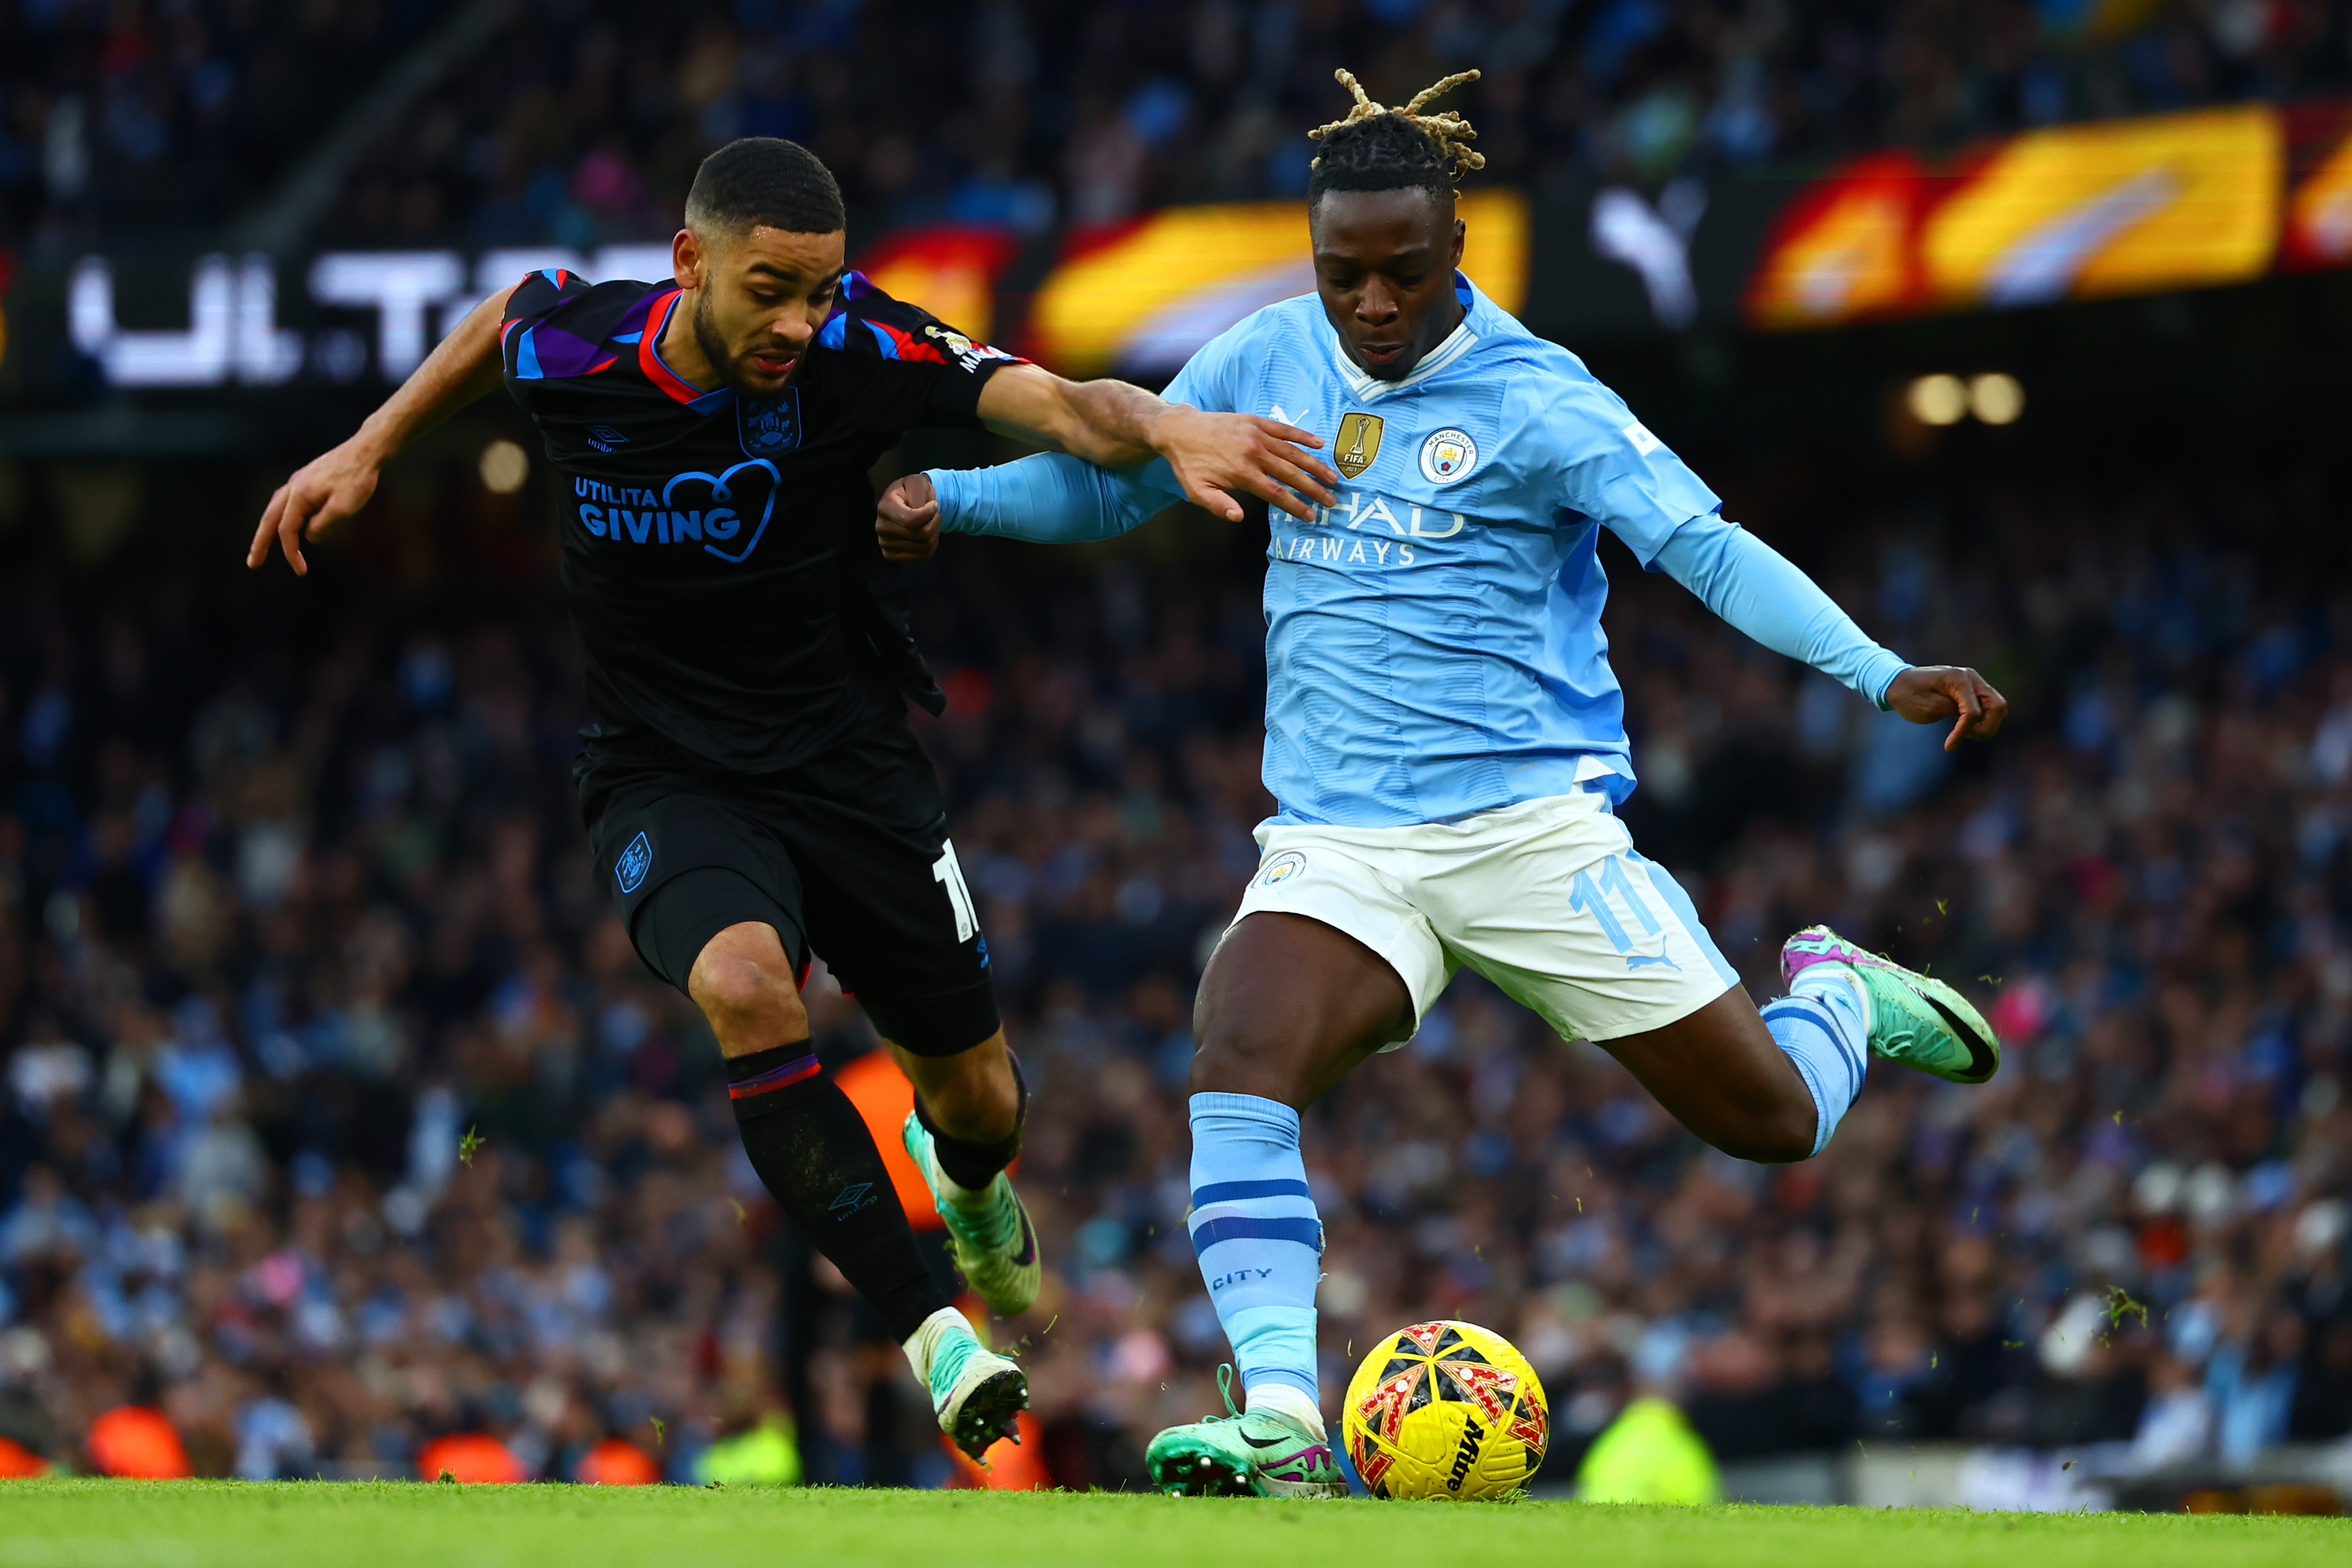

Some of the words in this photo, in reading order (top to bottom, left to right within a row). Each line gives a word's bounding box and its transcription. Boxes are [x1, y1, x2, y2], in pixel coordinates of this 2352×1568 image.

[588, 438, 617, 453] umbr
[1428, 432, 1474, 455] MANCHESTER
[1343, 454, 1364, 464] FIFA
[575, 476, 658, 508] UTILITA
[579, 503, 741, 544] GIVING
[1275, 536, 1414, 566] AIRWAYS
[1568, 854, 1663, 954] 11
[1212, 1267, 1272, 1291] CITY
[1446, 1413, 1485, 1491] Mitre
